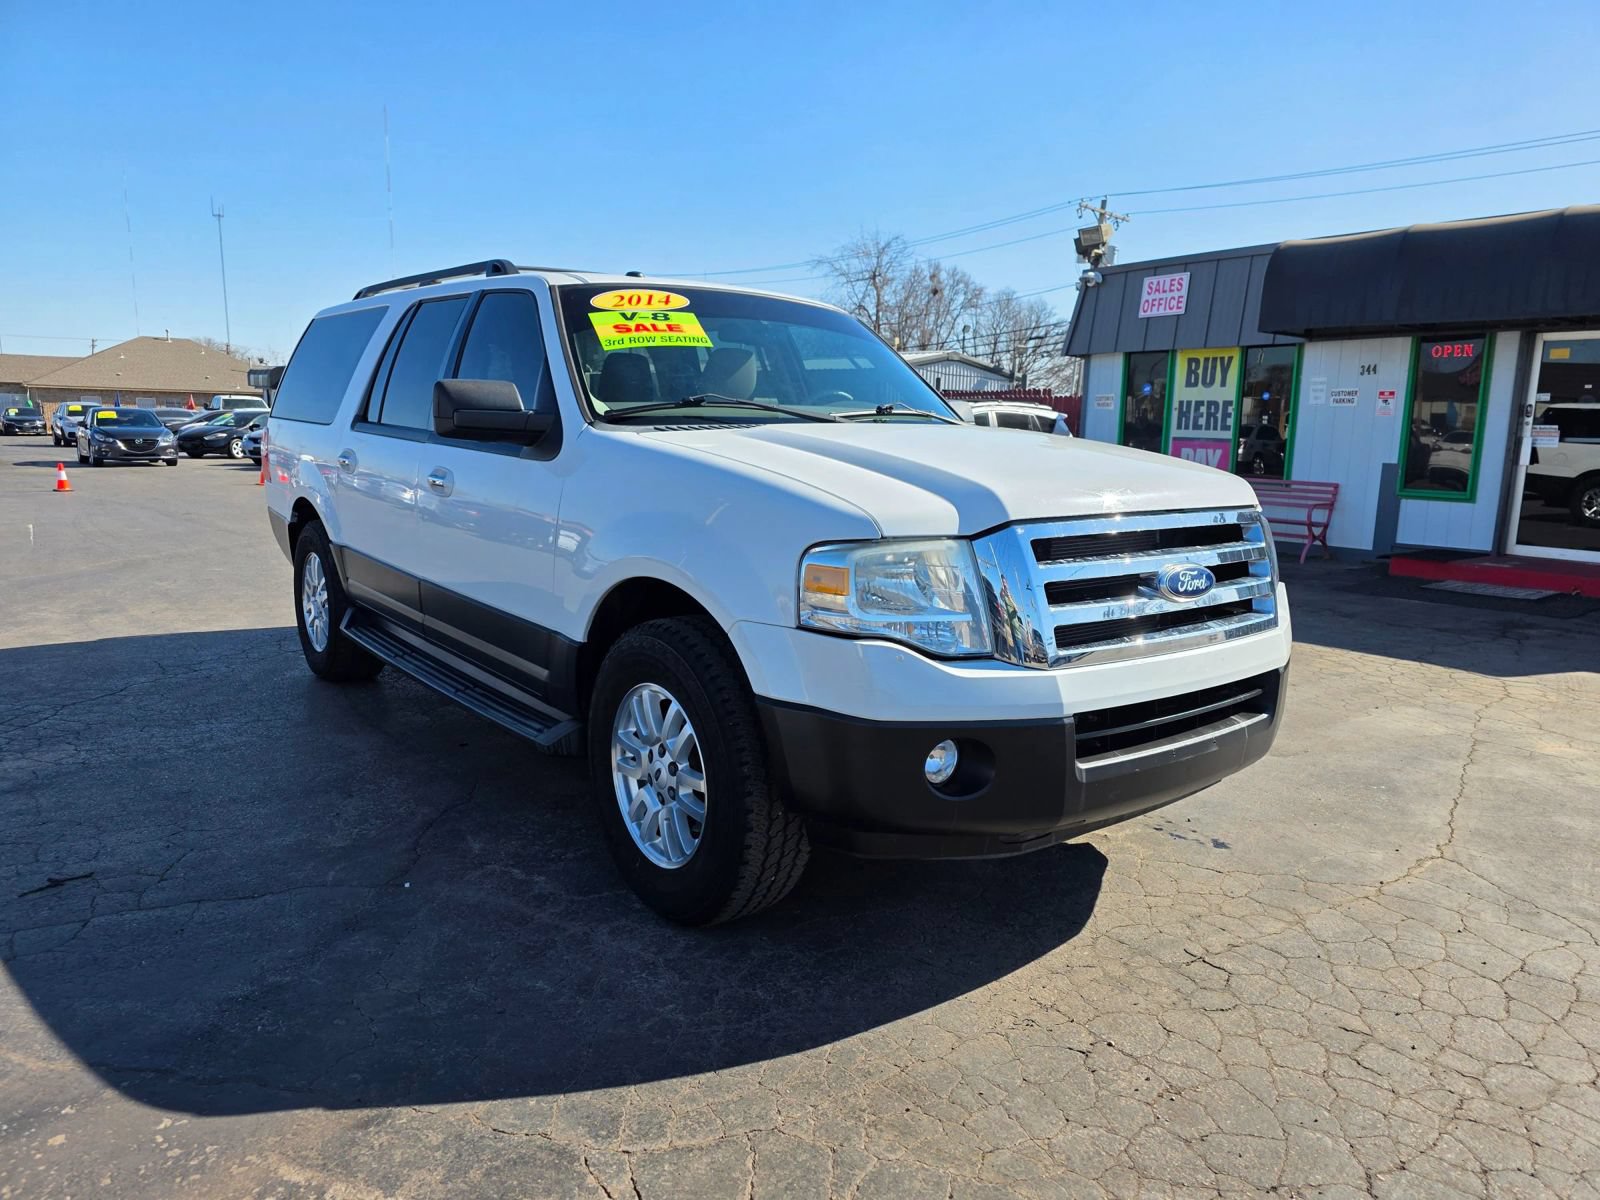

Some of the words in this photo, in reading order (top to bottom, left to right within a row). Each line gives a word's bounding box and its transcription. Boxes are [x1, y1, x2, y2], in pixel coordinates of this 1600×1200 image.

[1147, 277, 1184, 296] SALES
[612, 294, 671, 308] 2014
[1142, 295, 1184, 313] OFFICE
[619, 311, 671, 321] V-8
[612, 323, 684, 334] SALE
[604, 338, 625, 347] 3rd
[629, 336, 656, 344] ROW
[660, 335, 708, 344] SEATING
[1431, 344, 1473, 358] OPEN
[1184, 356, 1234, 388] BUY
[1360, 363, 1377, 376] 344
[1176, 400, 1234, 431] HERE
[1178, 570, 1206, 592] Ford
